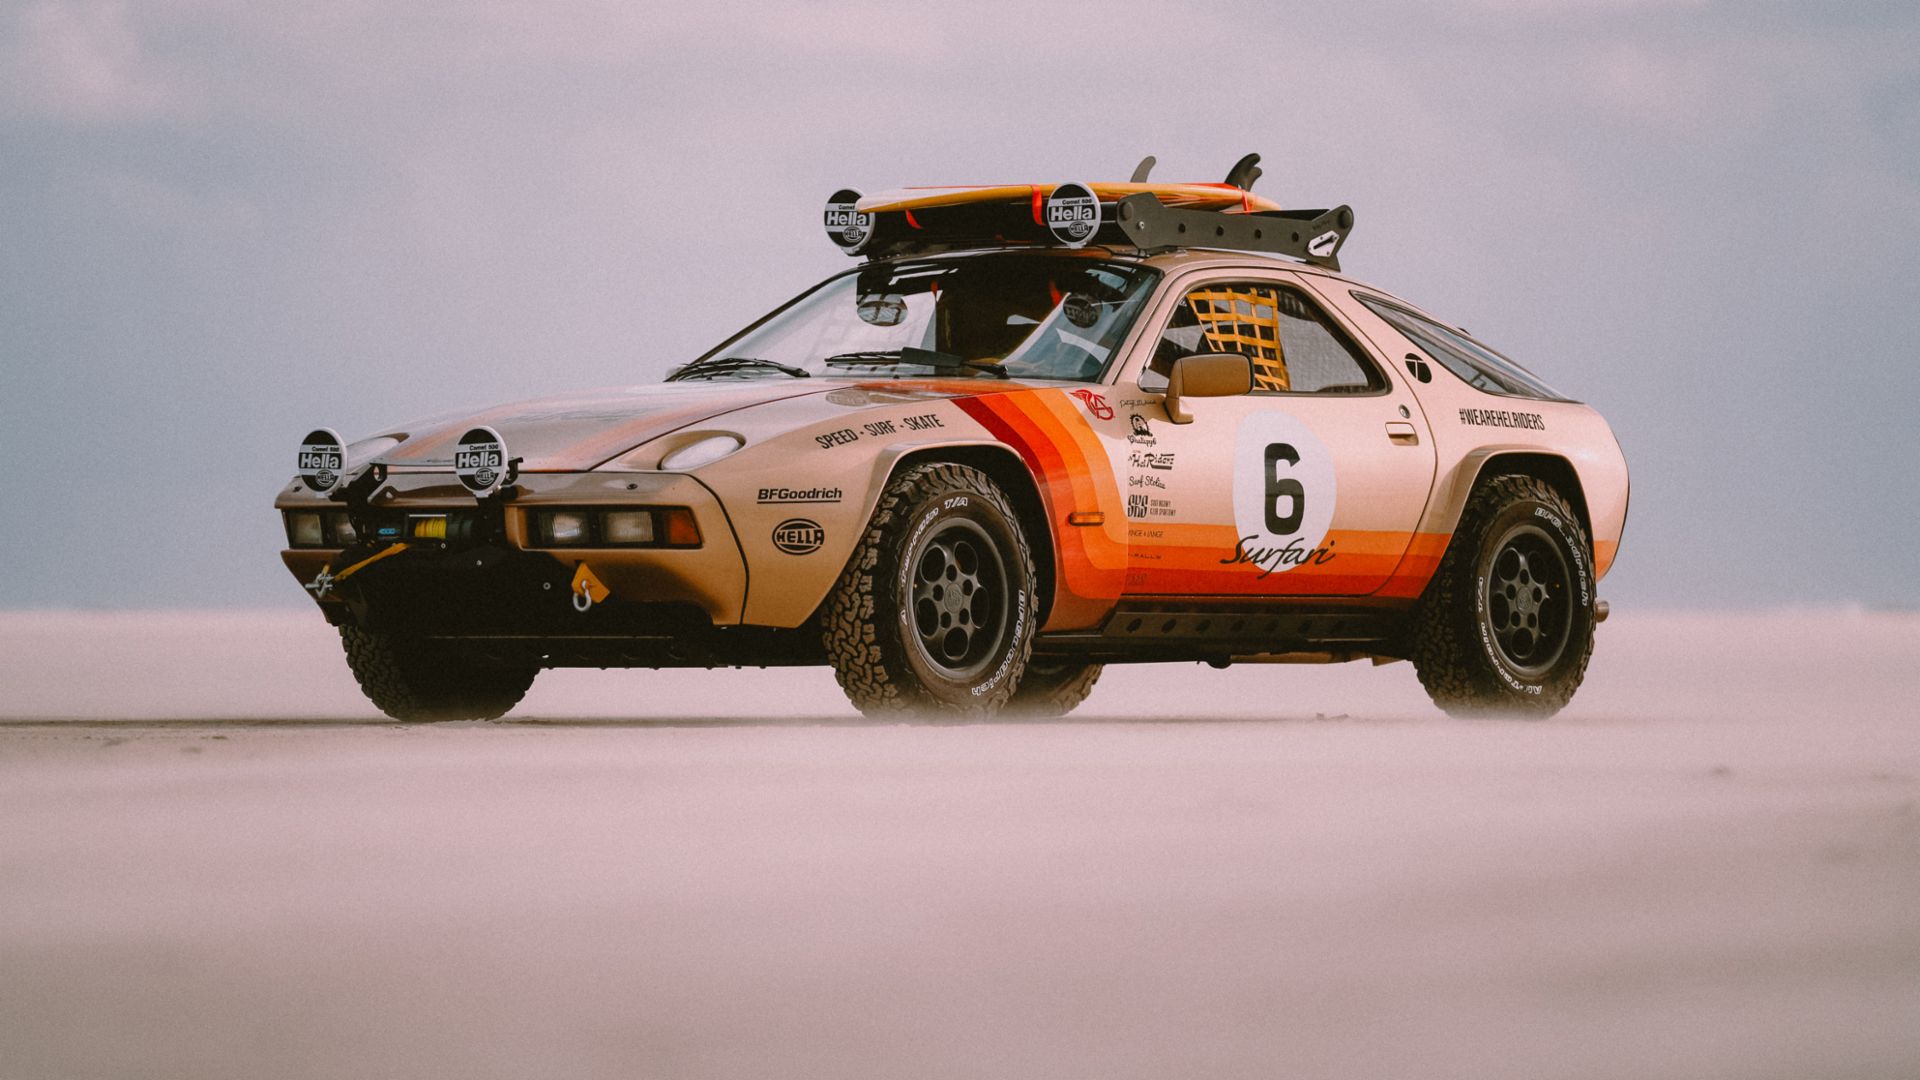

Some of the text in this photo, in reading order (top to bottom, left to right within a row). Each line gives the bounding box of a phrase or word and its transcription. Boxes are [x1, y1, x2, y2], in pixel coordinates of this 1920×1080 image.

[827, 211, 867, 225] Hella
[1051, 206, 1093, 221] Hella
[1459, 408, 1545, 431] #WEAREHELRIDERS
[815, 414, 945, 449] SPEED SURF SKATE
[300, 453, 340, 468] Hella
[458, 451, 499, 468] Hella
[757, 488, 843, 501] BFGoodrich
[1264, 442, 1305, 536] 6
[944, 497, 968, 510] T/A
[776, 530, 825, 545] HELLA
[1219, 534, 1336, 580] Surfari
